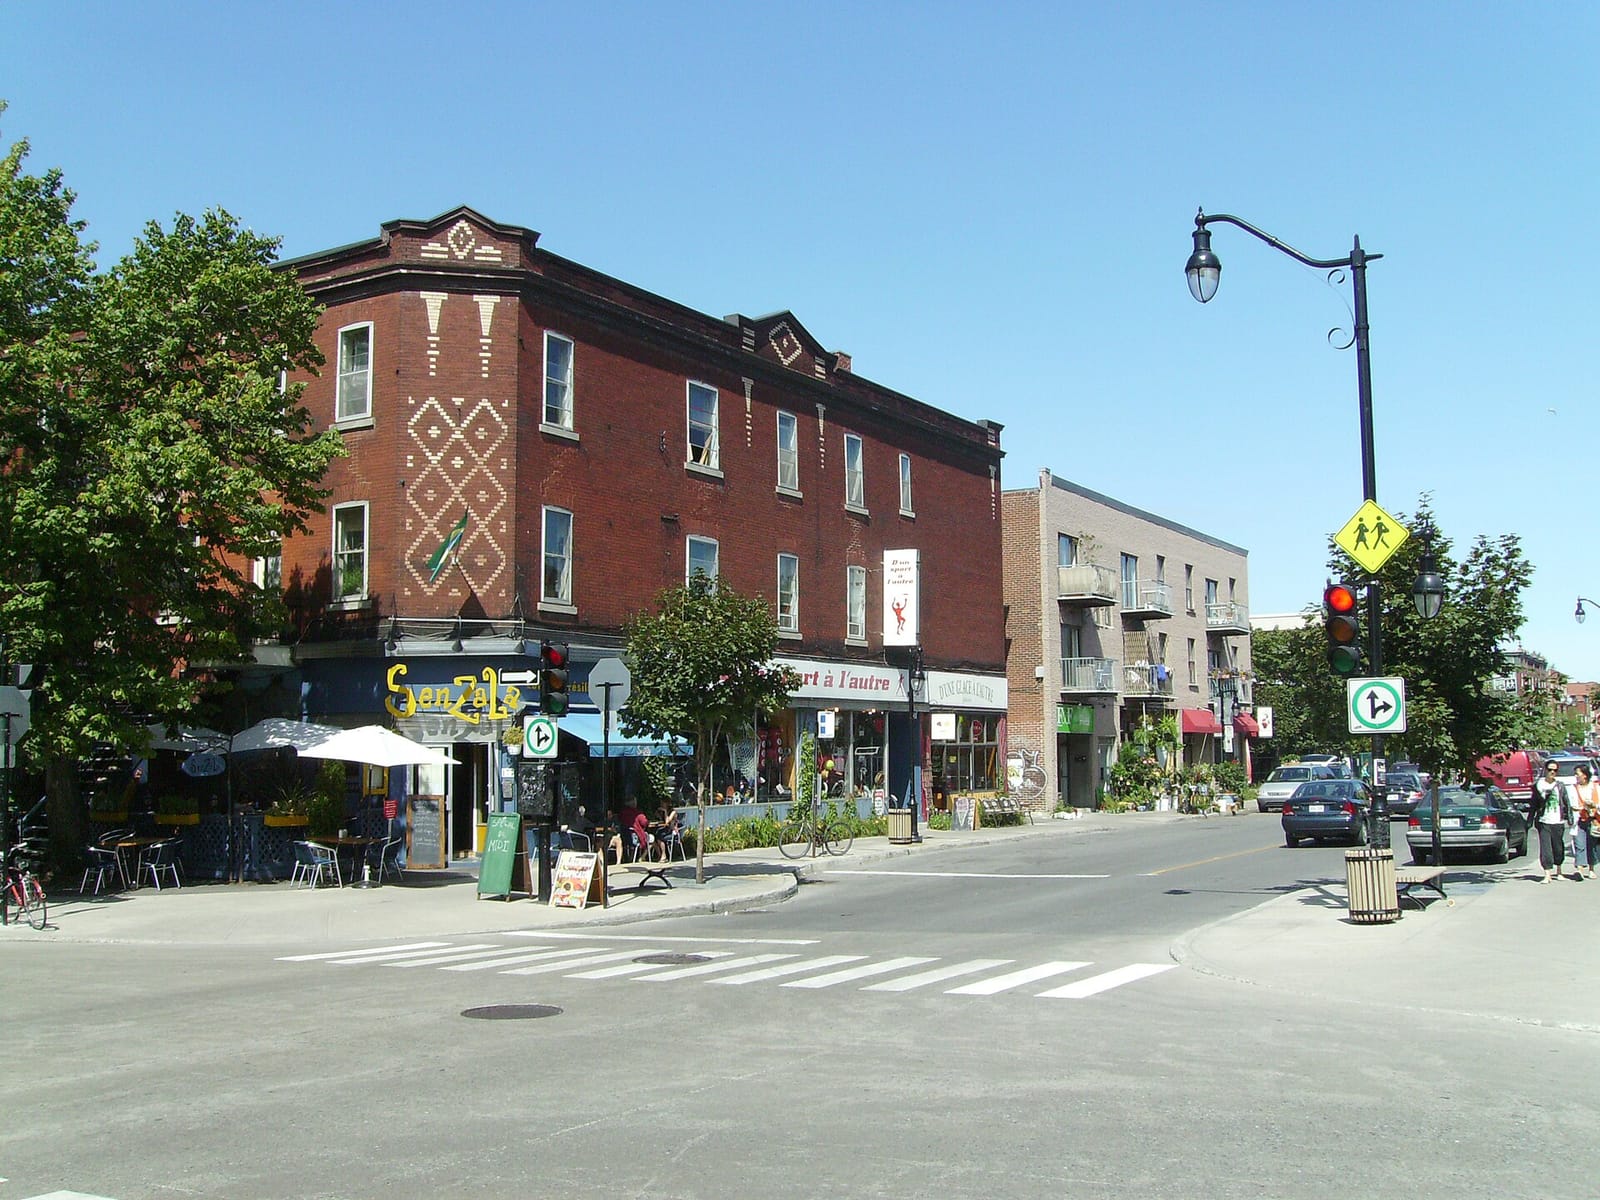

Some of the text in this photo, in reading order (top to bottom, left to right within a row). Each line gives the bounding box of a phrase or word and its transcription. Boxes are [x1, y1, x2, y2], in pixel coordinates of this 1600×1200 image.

[823, 669, 833, 688] à
[838, 670, 889, 691] l'autre
[487, 839, 510, 852] MIDI
